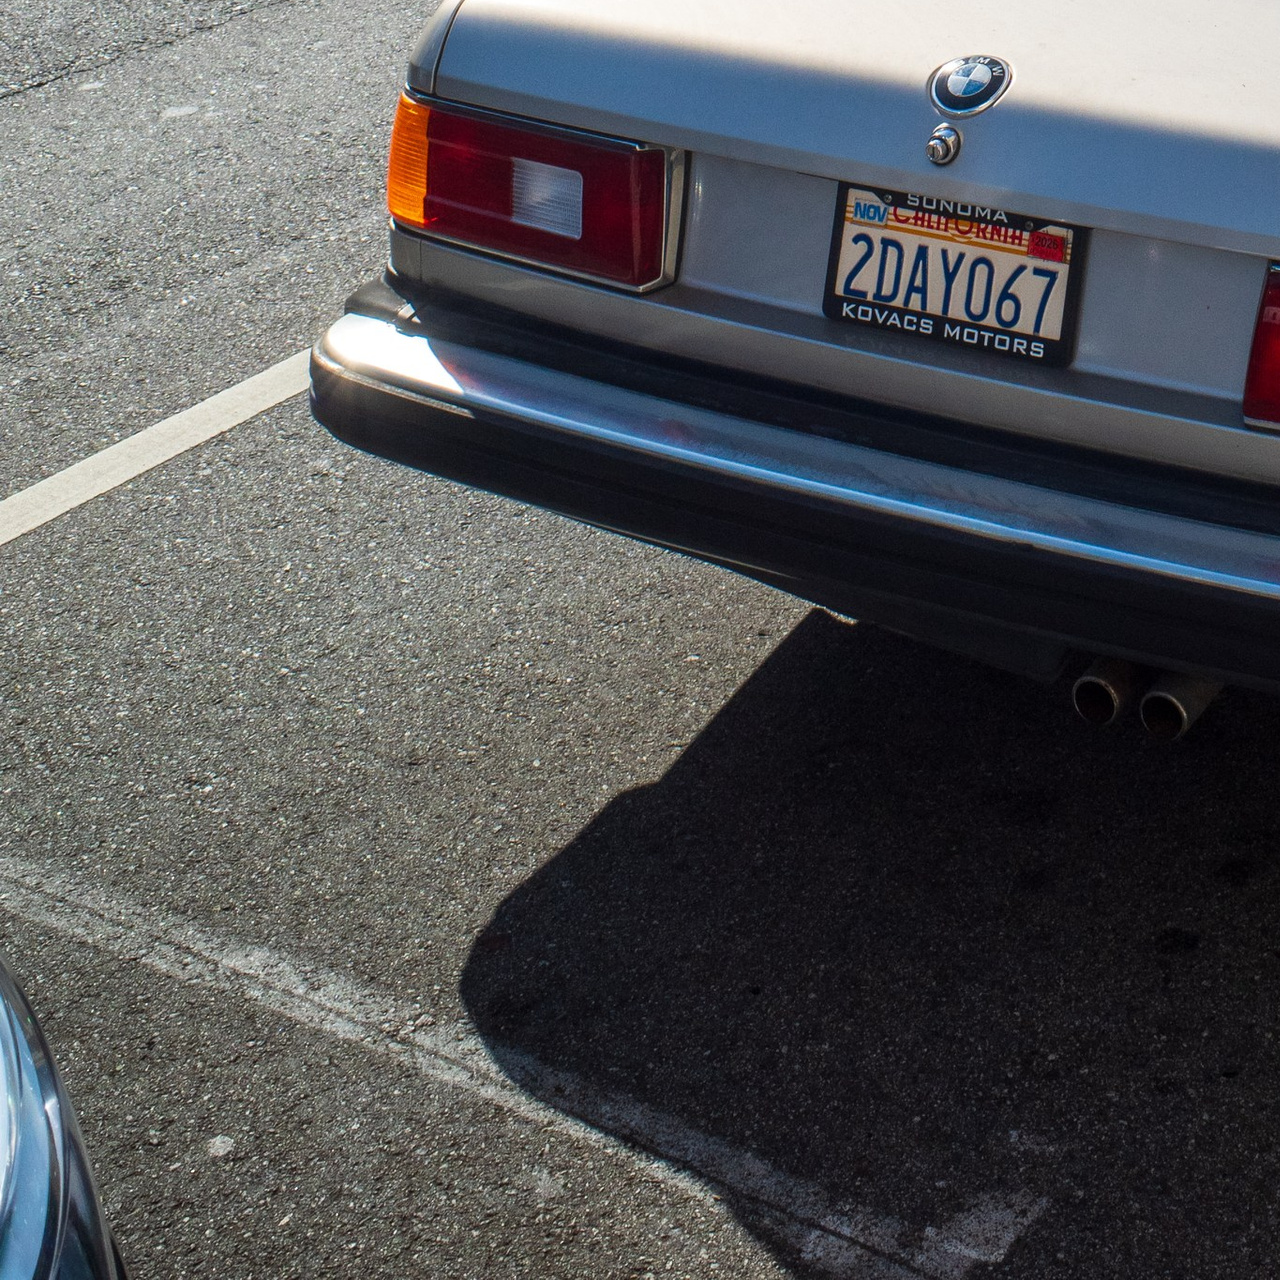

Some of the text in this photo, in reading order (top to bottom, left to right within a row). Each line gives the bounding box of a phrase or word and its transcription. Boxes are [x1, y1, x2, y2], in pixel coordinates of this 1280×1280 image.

[854, 201, 888, 223] NOV
[906, 193, 1009, 223] SONOMA
[843, 232, 1060, 336] 2DAY067
[842, 302, 1045, 359] KOVACS MOTORS
